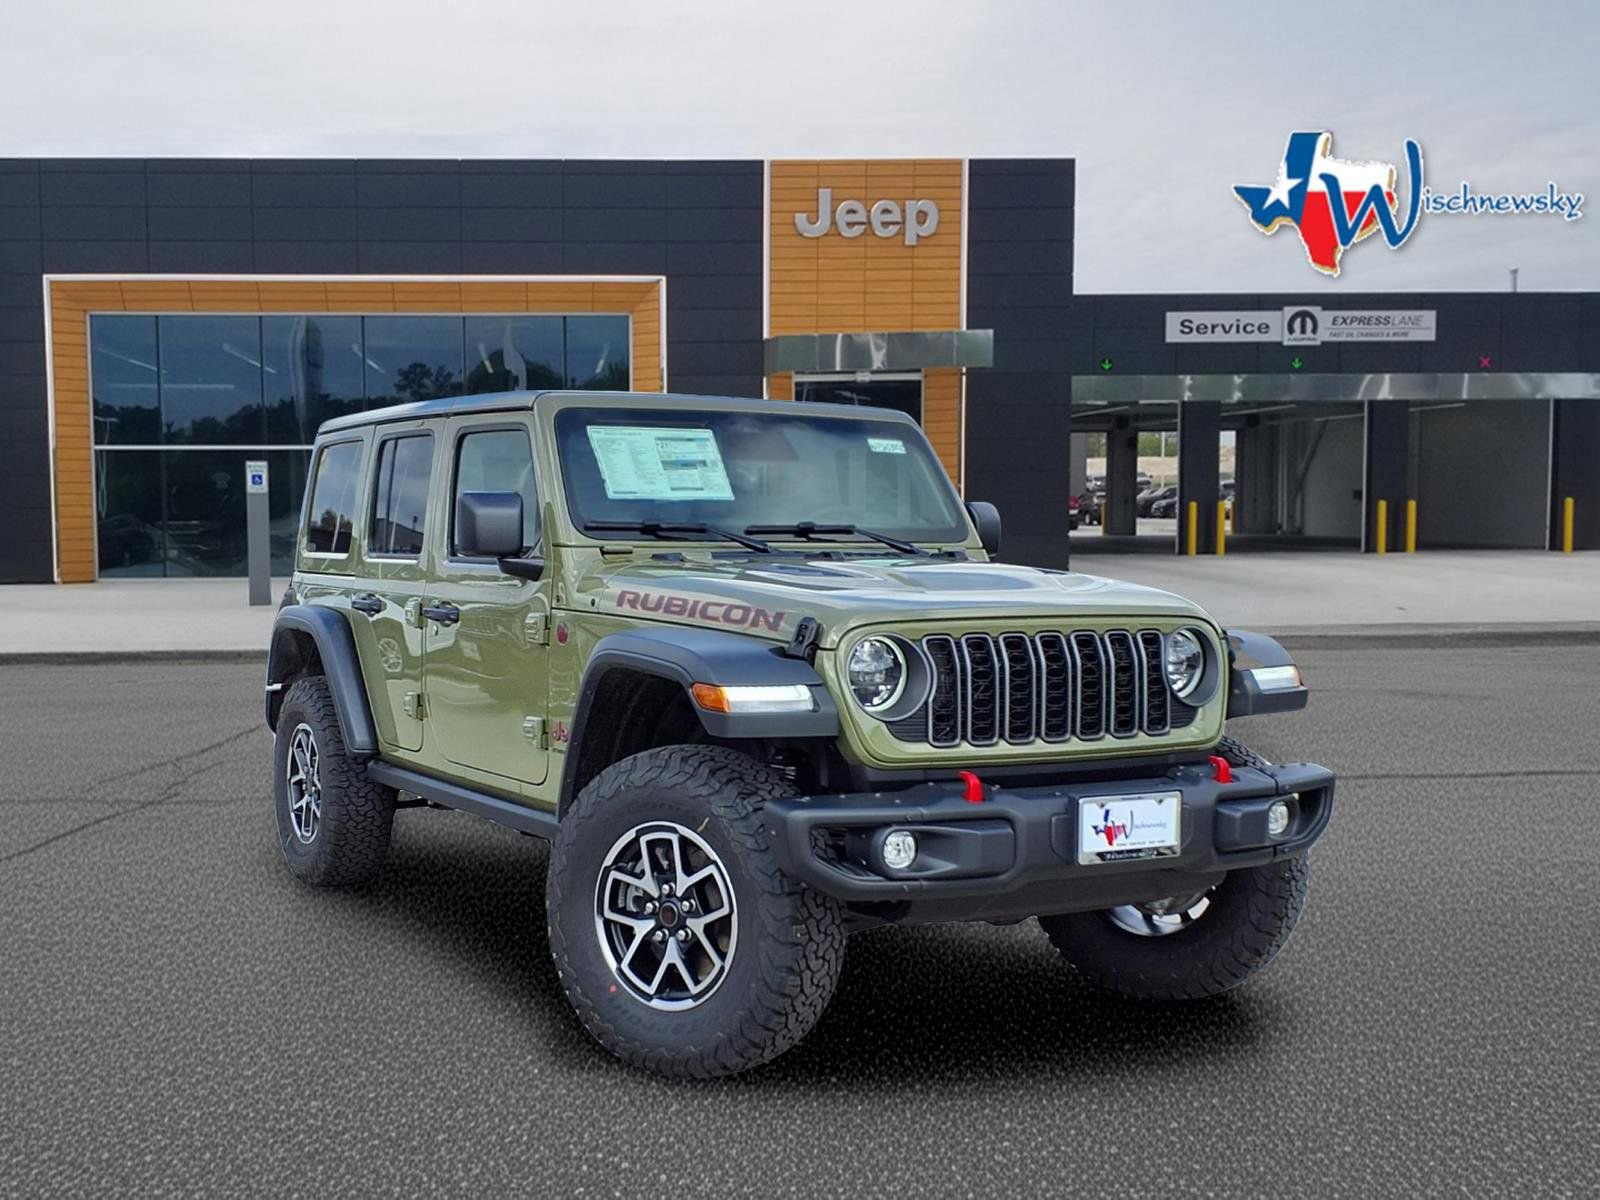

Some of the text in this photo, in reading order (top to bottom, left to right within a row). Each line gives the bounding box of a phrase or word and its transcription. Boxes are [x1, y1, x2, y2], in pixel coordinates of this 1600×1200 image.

[794, 187, 939, 246] Jeep
[1179, 318, 1270, 335] Service
[616, 590, 786, 632] RUBICON
